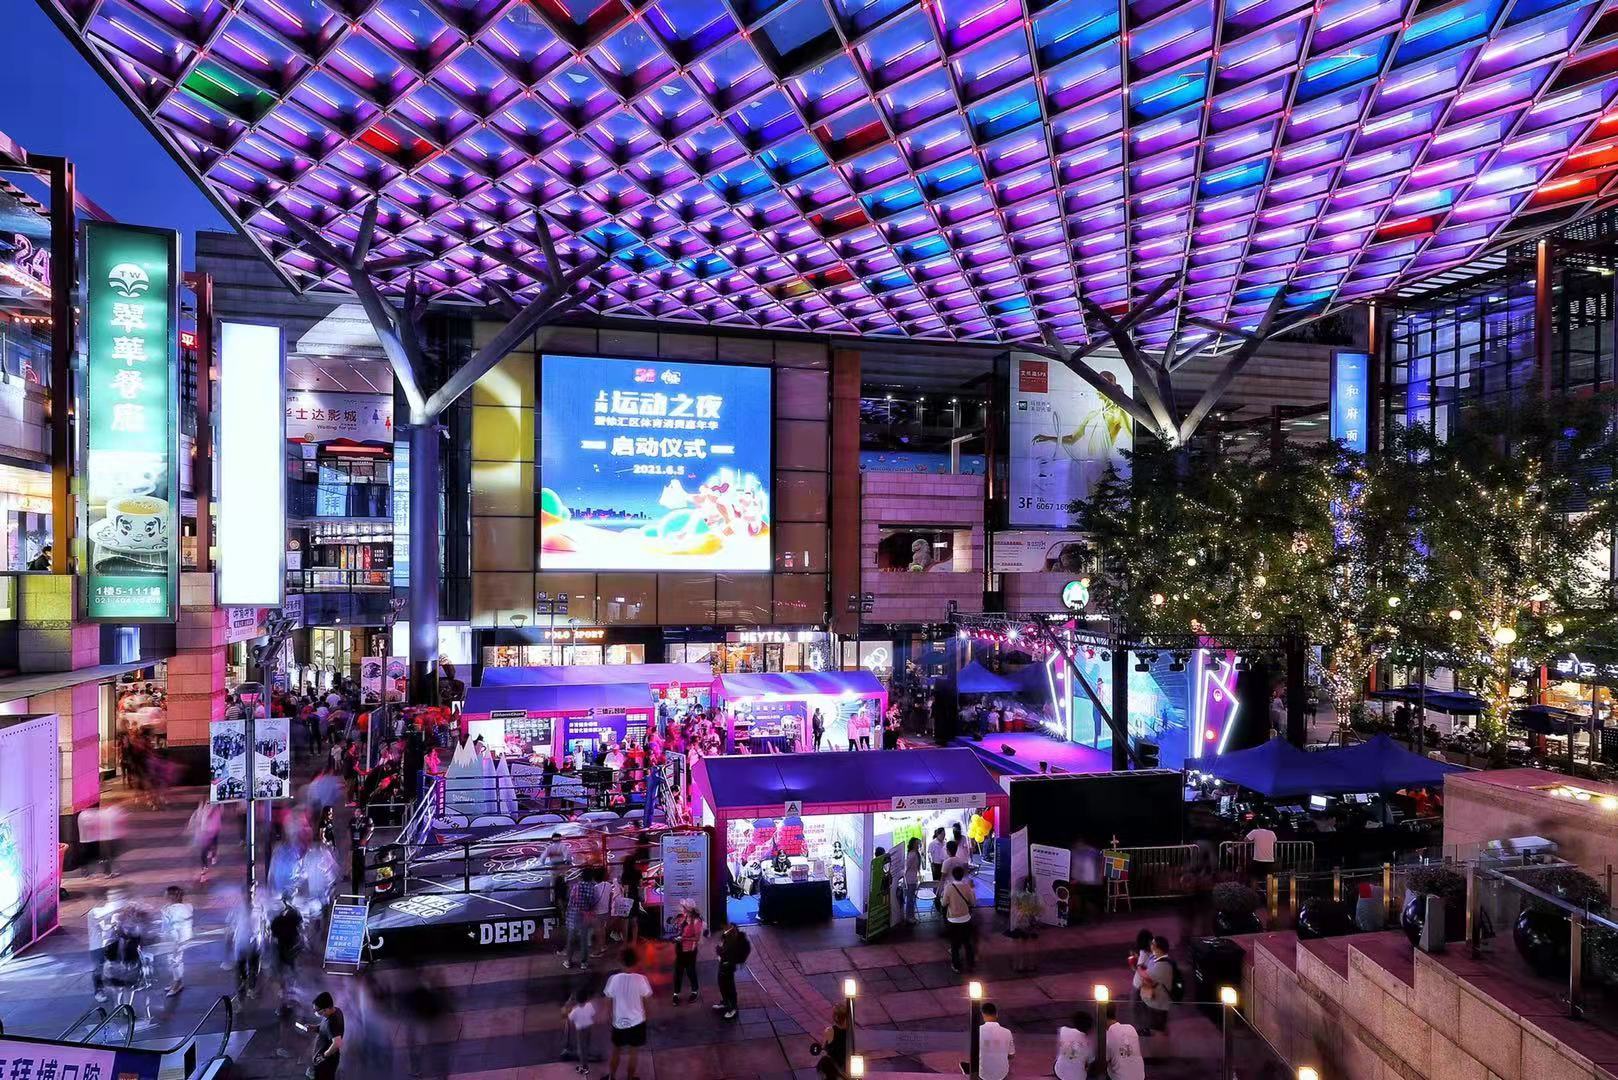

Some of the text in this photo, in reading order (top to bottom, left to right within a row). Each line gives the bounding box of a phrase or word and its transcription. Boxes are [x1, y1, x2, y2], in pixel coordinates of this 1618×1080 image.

[611, 390, 723, 418] 运动之夜
[611, 436, 707, 459] 启动仪式
[633, 464, 685, 475] 2021.6.5
[1018, 497, 1033, 509] 3F
[544, 630, 605, 640] POLO SPORT
[739, 632, 790, 643] HEYTEA
[479, 920, 536, 945] DEEP
